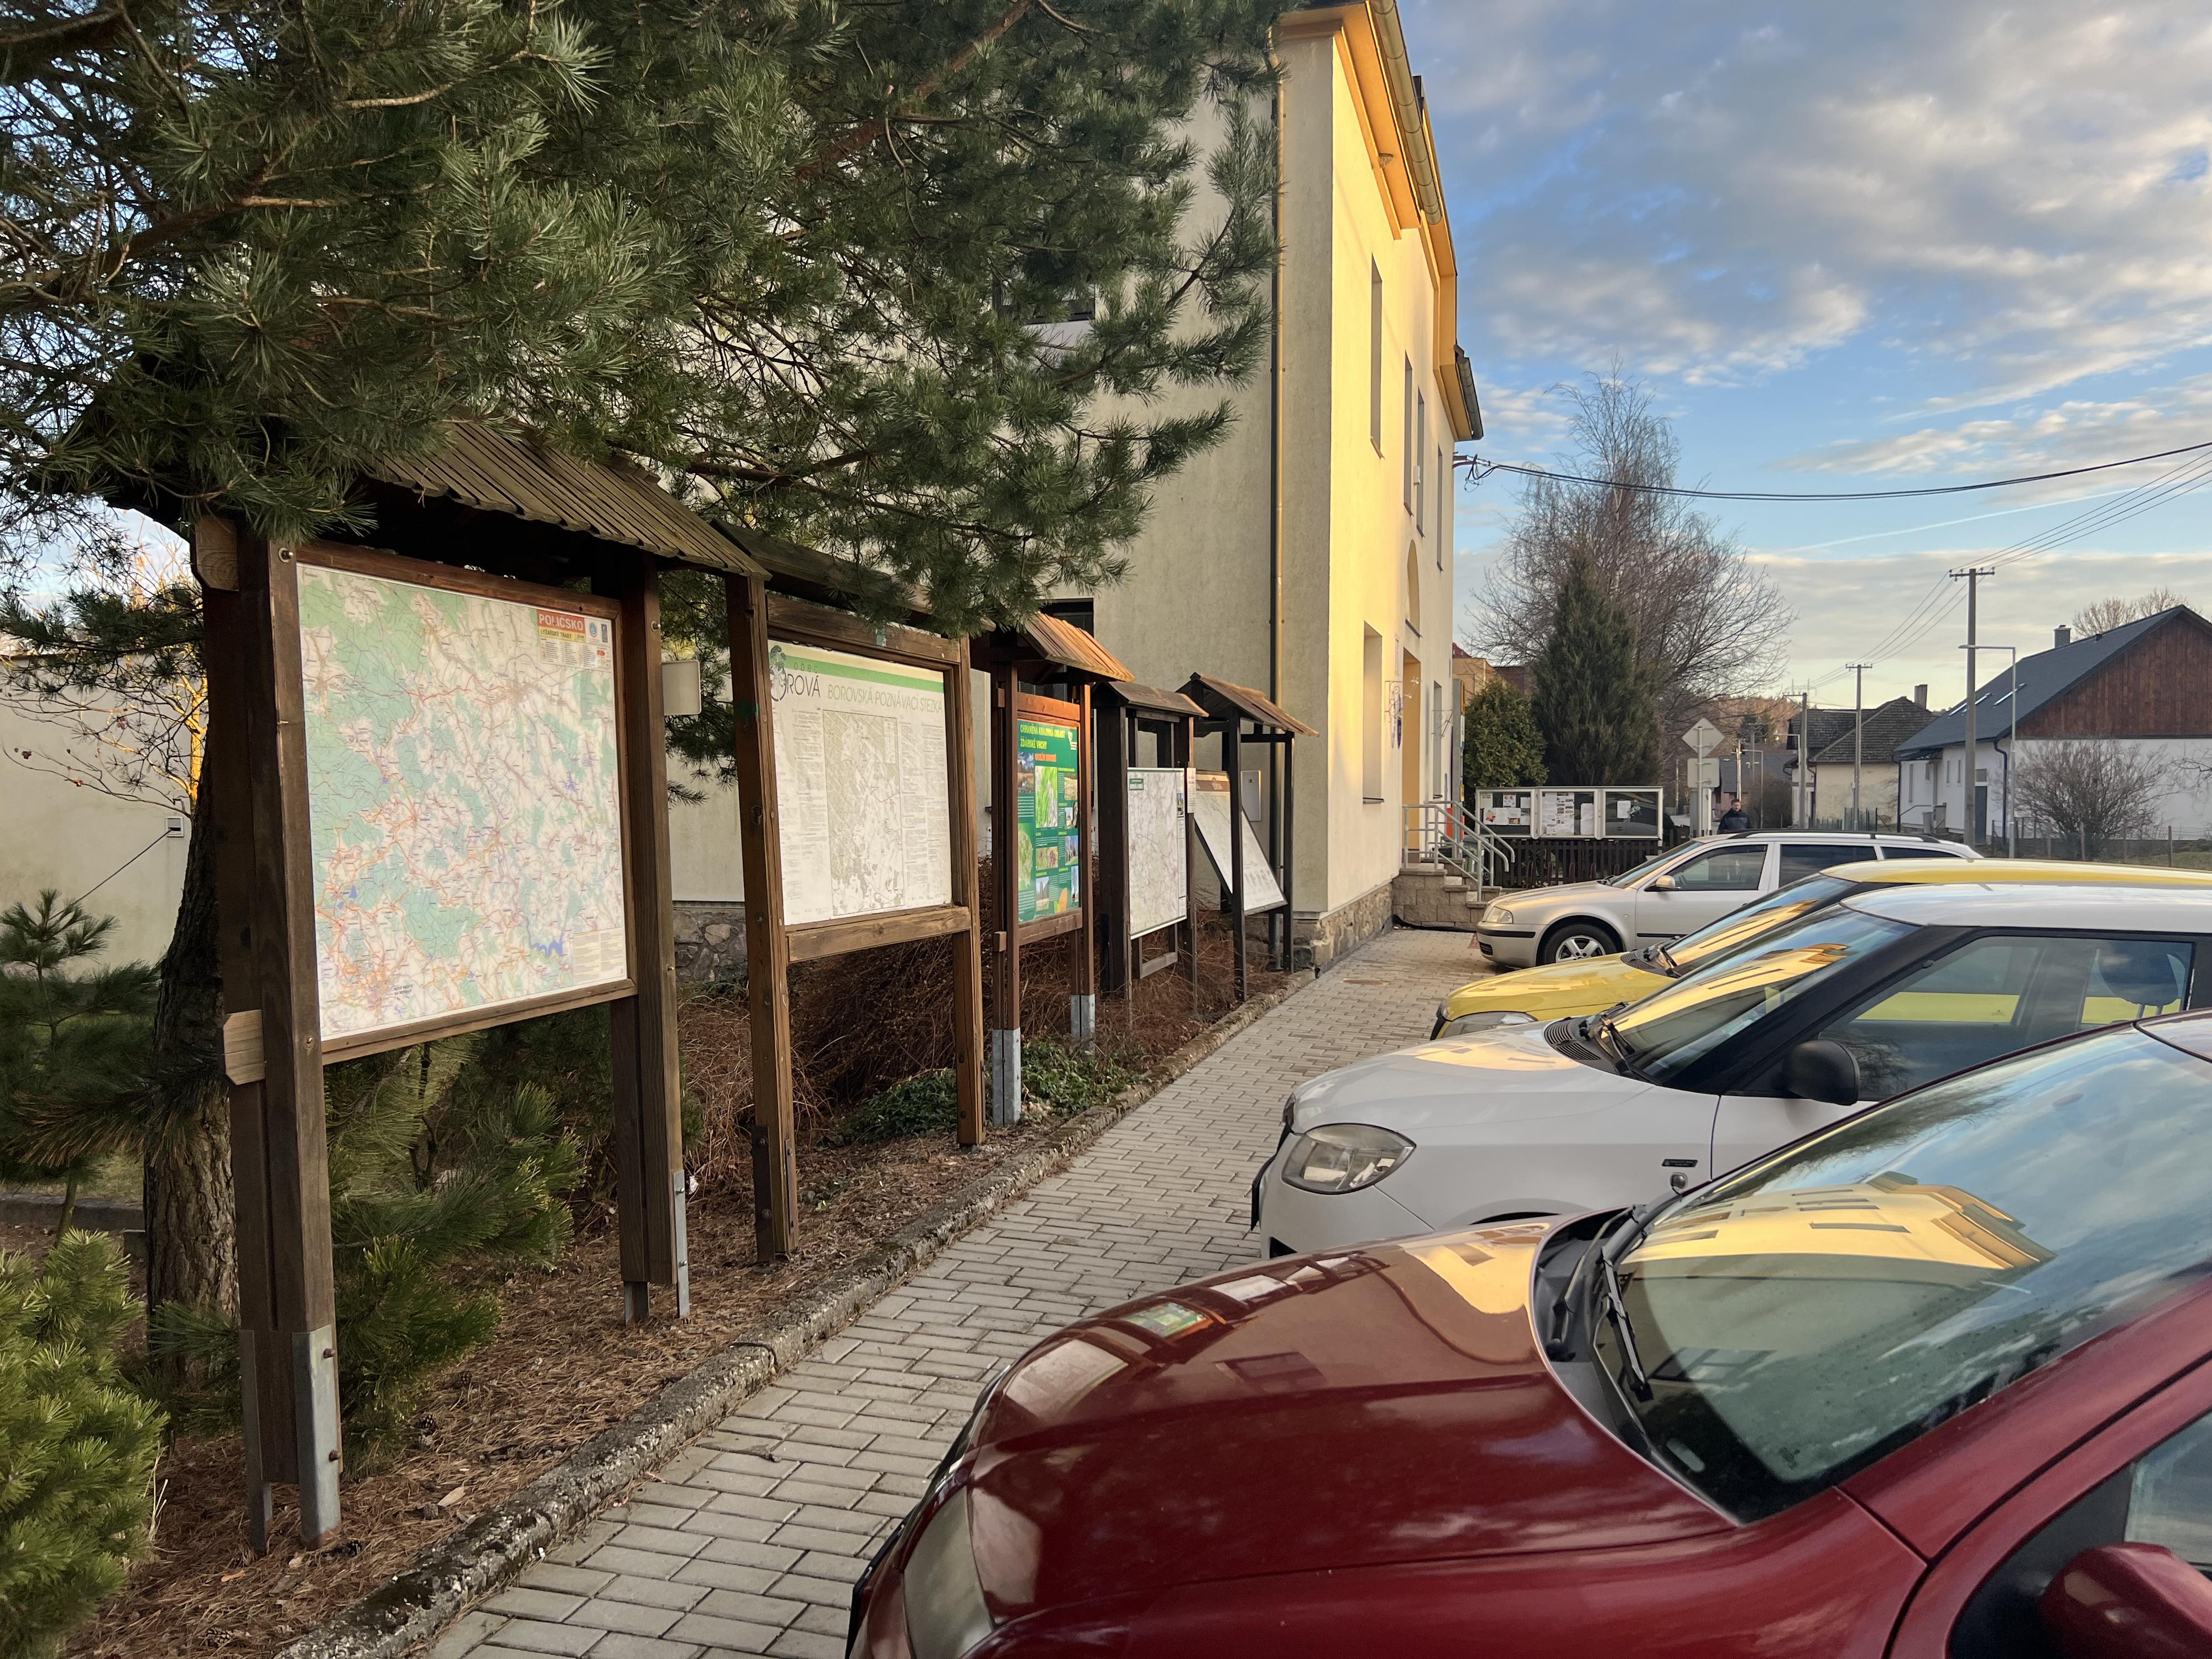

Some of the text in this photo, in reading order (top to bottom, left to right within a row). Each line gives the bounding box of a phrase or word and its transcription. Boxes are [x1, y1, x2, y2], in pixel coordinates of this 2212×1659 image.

[539, 613, 584, 631] POLIČSKO
[794, 662, 818, 674] obec
[828, 684, 943, 713] BOROVSKÁ POZNÁVACÍ STEZKA
